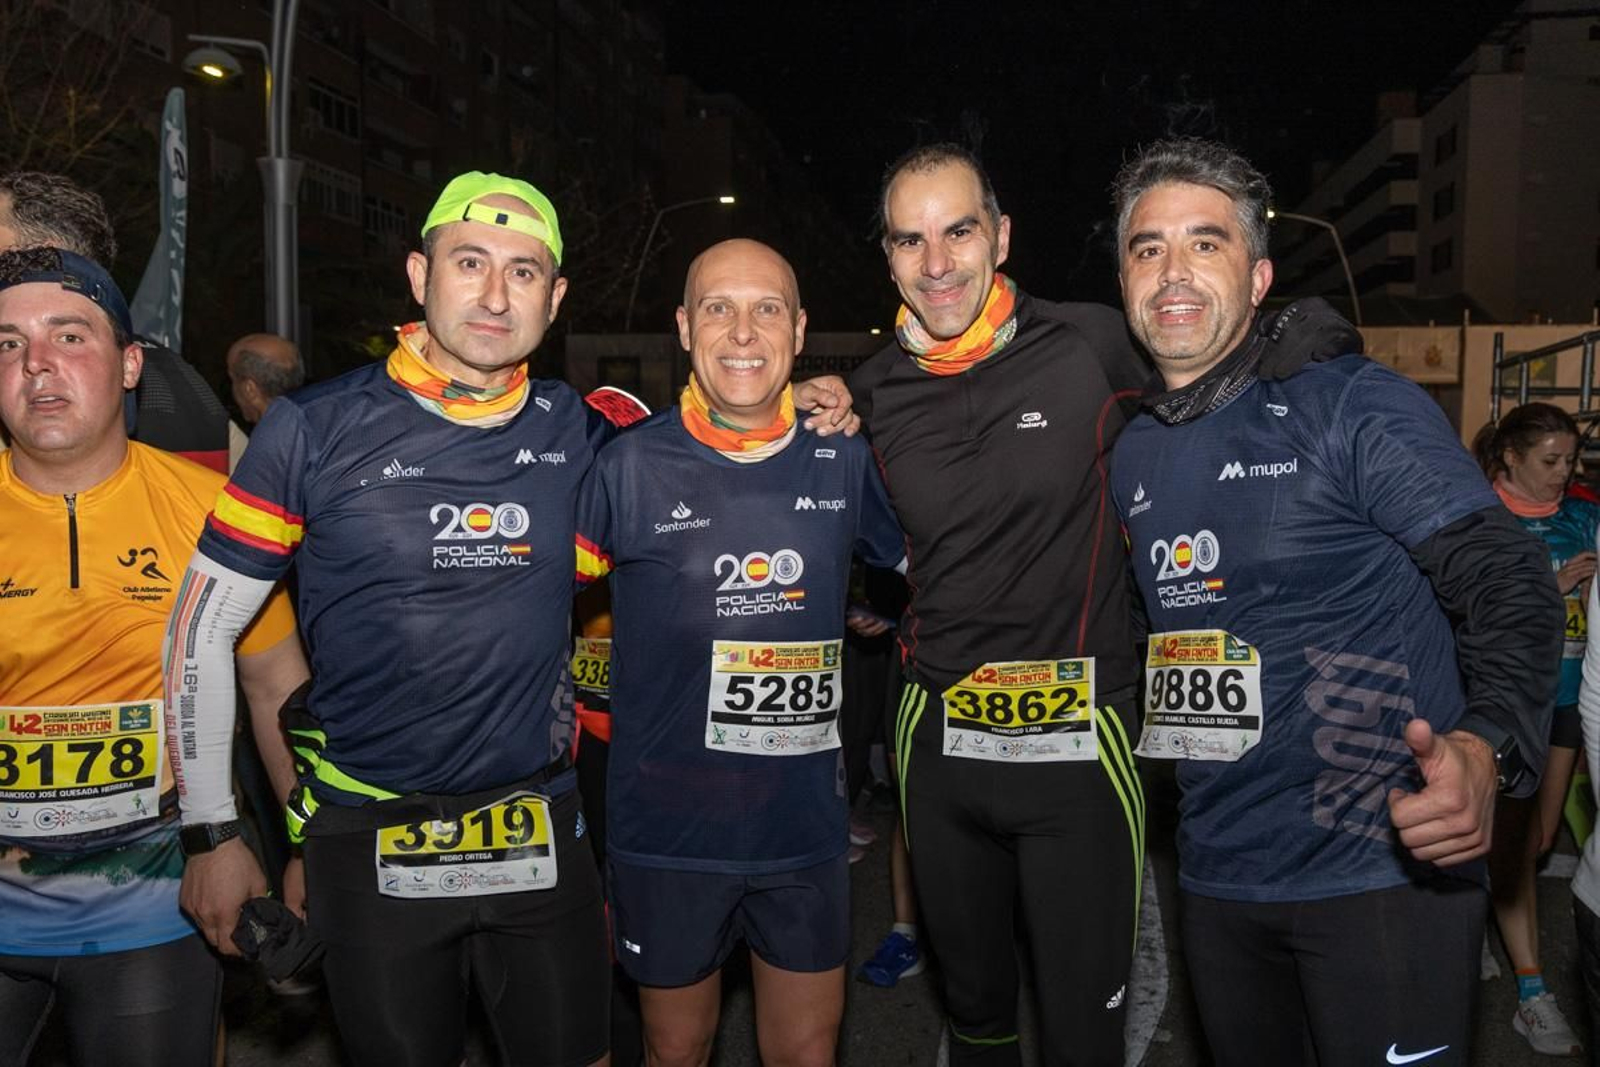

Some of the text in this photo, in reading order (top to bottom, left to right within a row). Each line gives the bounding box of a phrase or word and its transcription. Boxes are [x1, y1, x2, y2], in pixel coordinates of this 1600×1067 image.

[1250, 458, 1298, 478] mupol
[429, 502, 530, 541] 200
[654, 518, 711, 534] Santander
[433, 544, 512, 557] POLICIA
[1150, 529, 1220, 582] 200
[433, 555, 530, 569] NACIONAL
[714, 548, 804, 591] 200
[1158, 580, 1208, 598] POLICIA
[716, 592, 787, 606] POLICIA
[1161, 592, 1227, 609] NACIONAL
[716, 602, 805, 617] NACIONAL
[748, 648, 774, 667] 42
[972, 668, 997, 684] 42
[724, 672, 834, 712] 5285
[1150, 668, 1247, 713] 9886
[954, 687, 1078, 725] 3862
[9, 713, 42, 735] 42
[44, 723, 69, 733] SAN
[166, 714, 177, 730] DEL
[181, 721, 195, 729] AL
[1164, 716, 1186, 724] MANUEL
[1187, 716, 1215, 725] CASTILLO
[181, 731, 197, 760] PANTANO
[38, 789, 57, 799] JOSÉ
[60, 786, 98, 797] QUESADA
[101, 782, 134, 794] HERRERA
[393, 804, 535, 852] 3919
[439, 852, 492, 863] PEDRO ORTEGA
